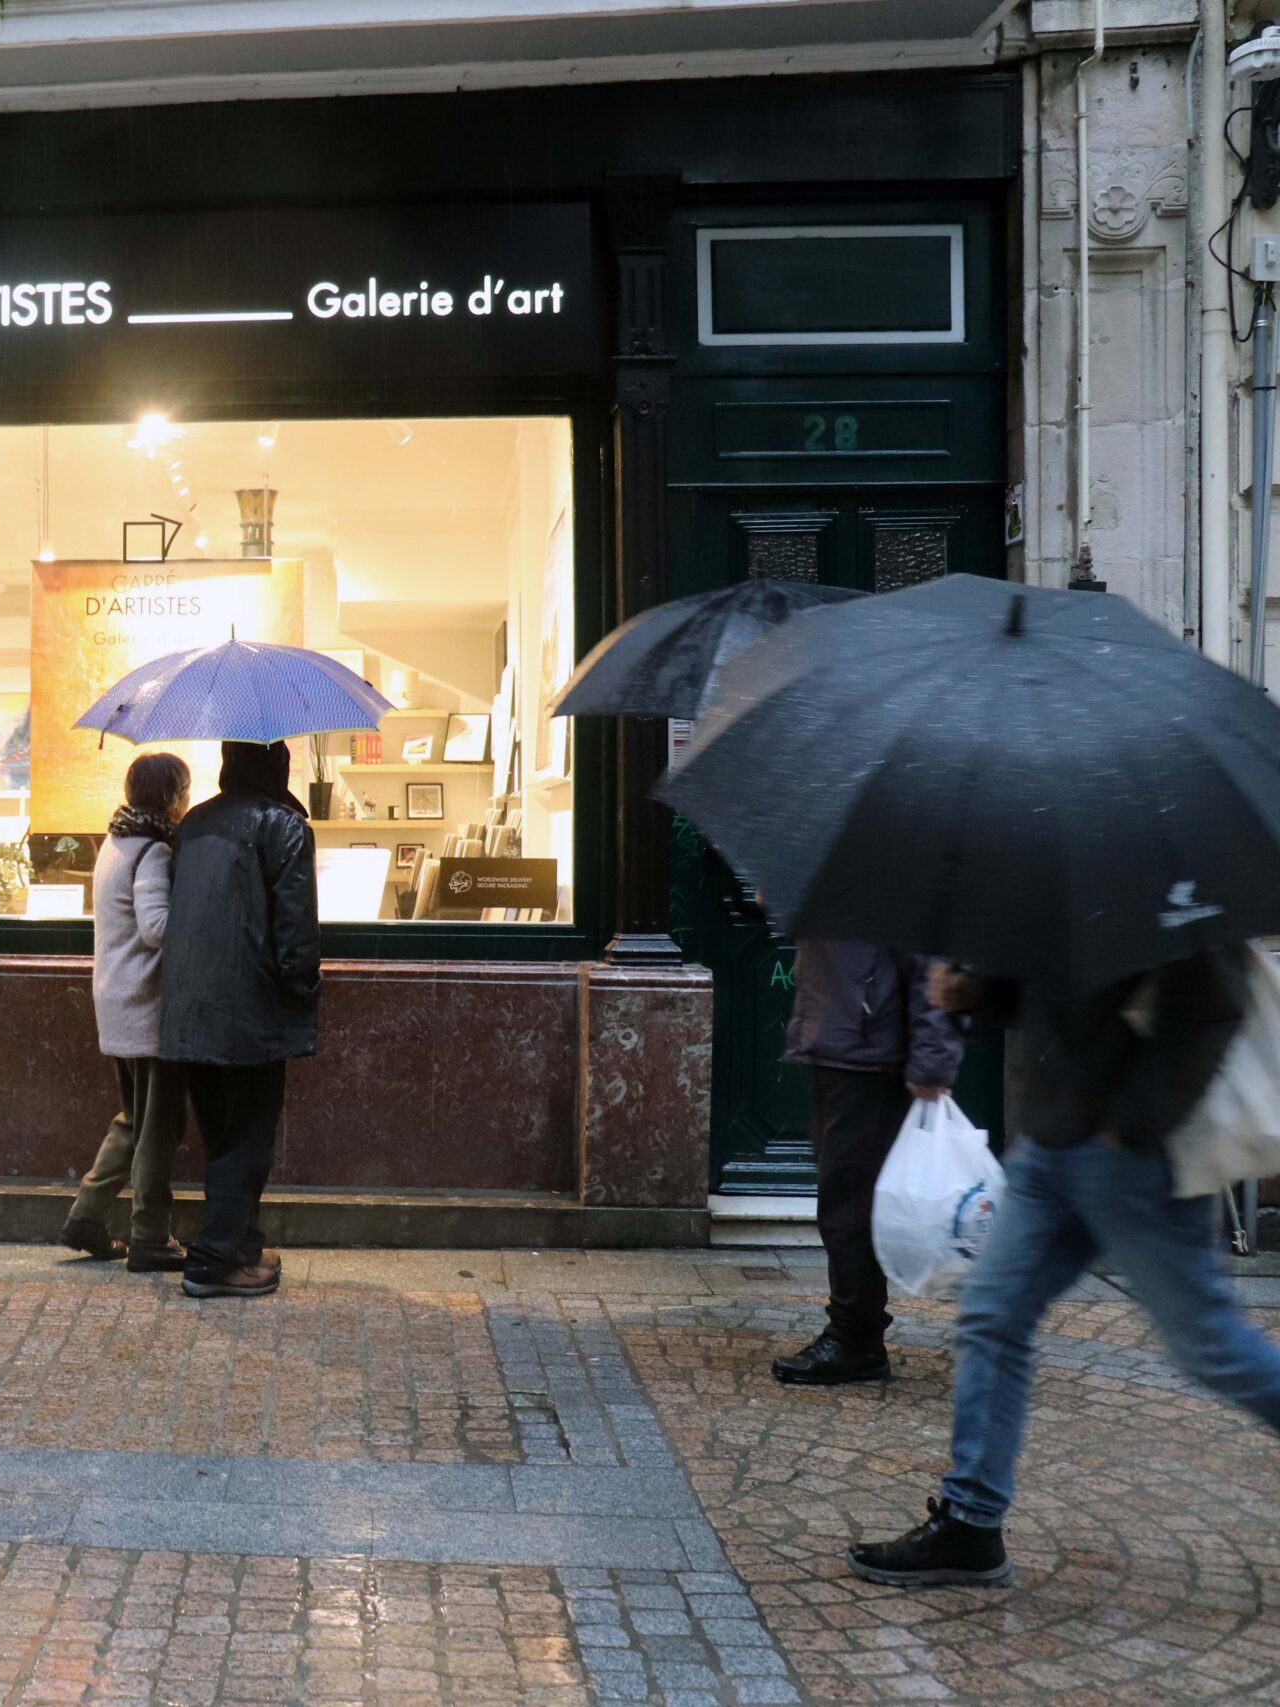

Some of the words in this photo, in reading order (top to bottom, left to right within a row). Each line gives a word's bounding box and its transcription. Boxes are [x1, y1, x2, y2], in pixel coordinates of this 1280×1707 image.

[307, 276, 454, 319] Galerie
[467, 274, 564, 316] d'art
[803, 415, 858, 452] 28
[85, 596, 202, 617] D'ARTISTES
